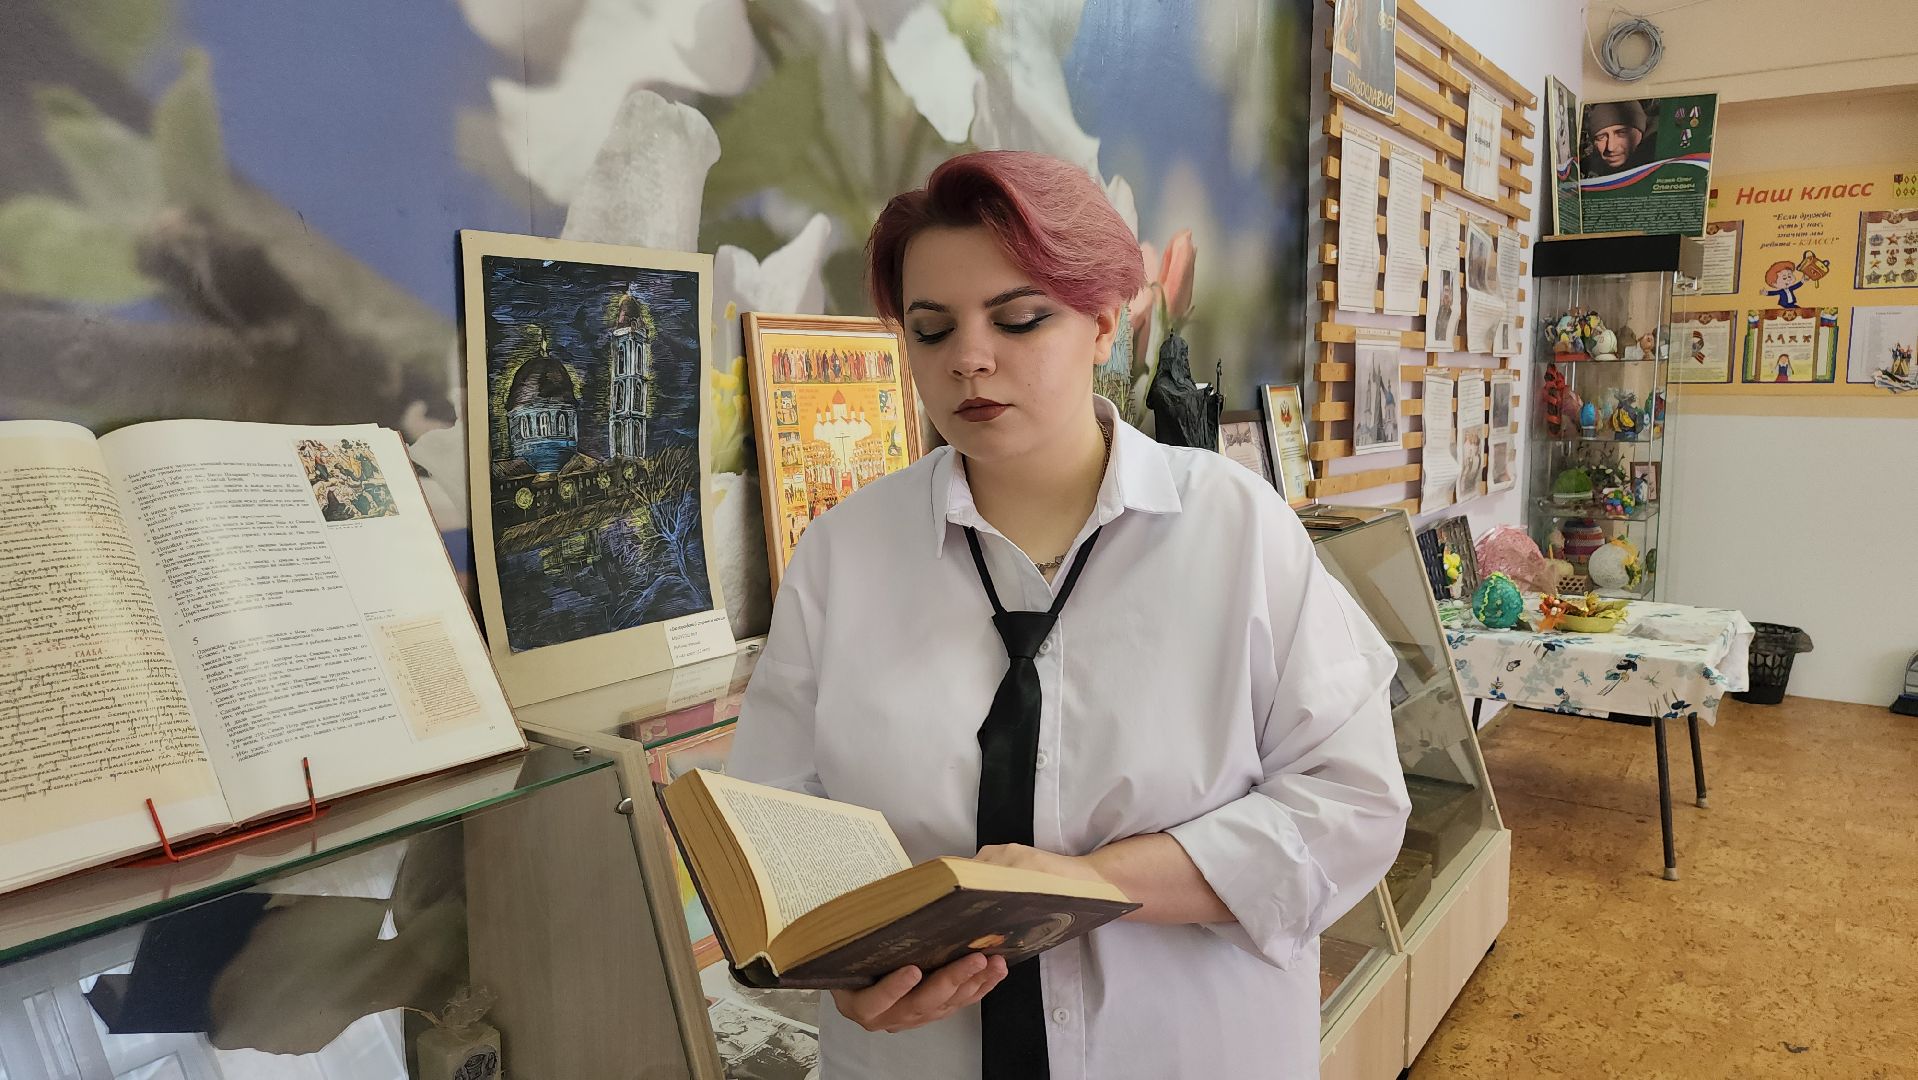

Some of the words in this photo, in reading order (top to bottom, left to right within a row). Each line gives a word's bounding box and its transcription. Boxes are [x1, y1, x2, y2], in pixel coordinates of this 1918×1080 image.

[1736, 186, 1794, 206] Наш
[1800, 182, 1875, 201] класс
[1800, 210, 1832, 222] дружба
[1760, 240, 1792, 250] ребята
